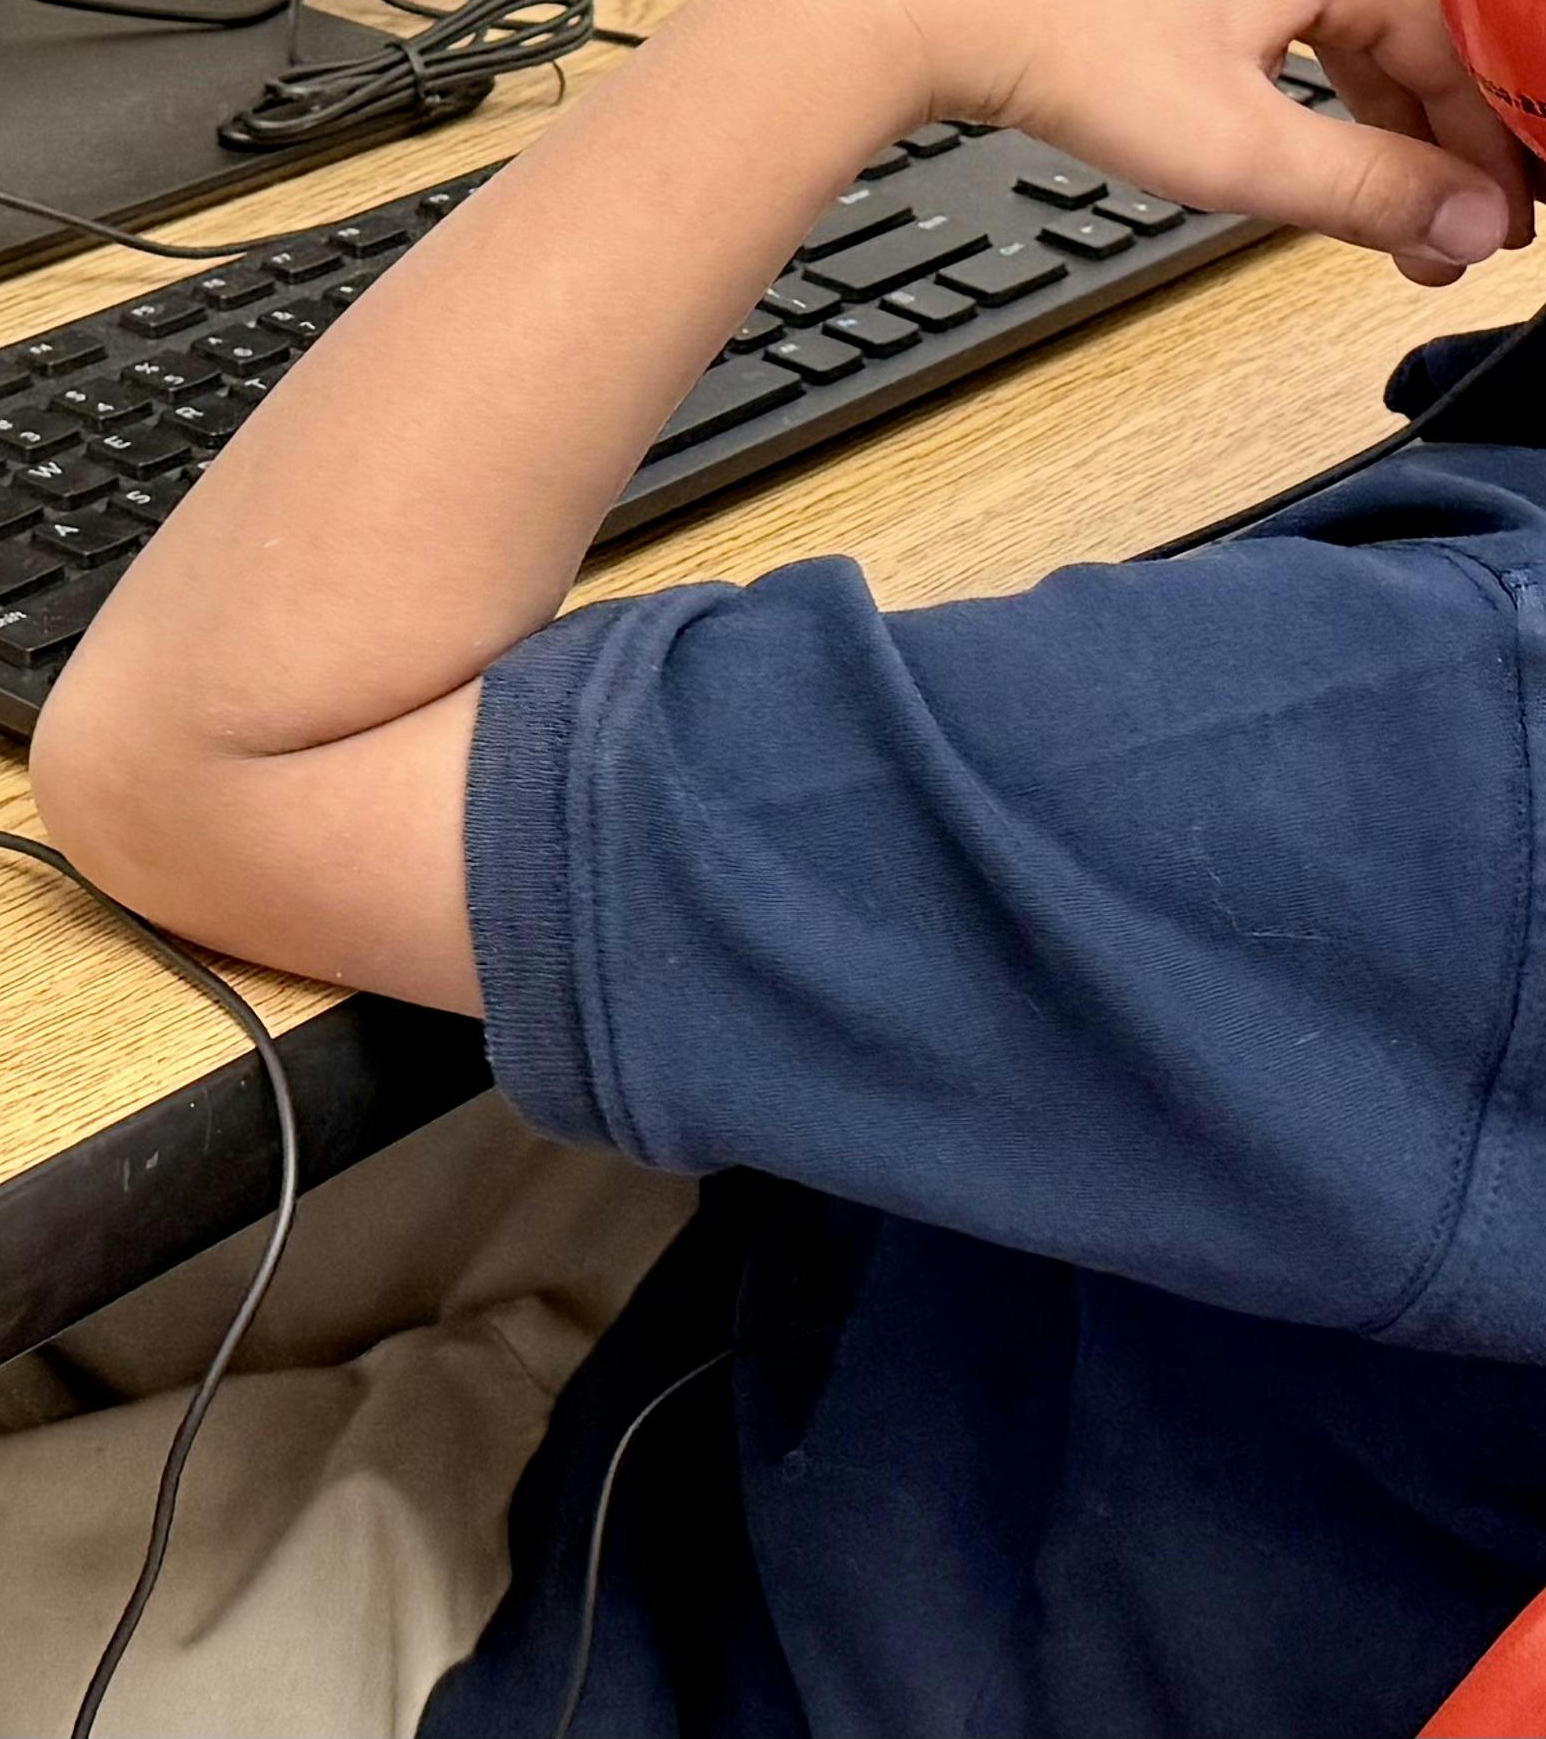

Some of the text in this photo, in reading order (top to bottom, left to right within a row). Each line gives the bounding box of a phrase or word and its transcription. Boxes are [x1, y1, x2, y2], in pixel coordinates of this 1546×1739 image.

[175, 406, 205, 419] R
[104, 435, 132, 449] E
[27, 461, 63, 478] W
[126, 490, 152, 504] S
[55, 524, 80, 537] A
